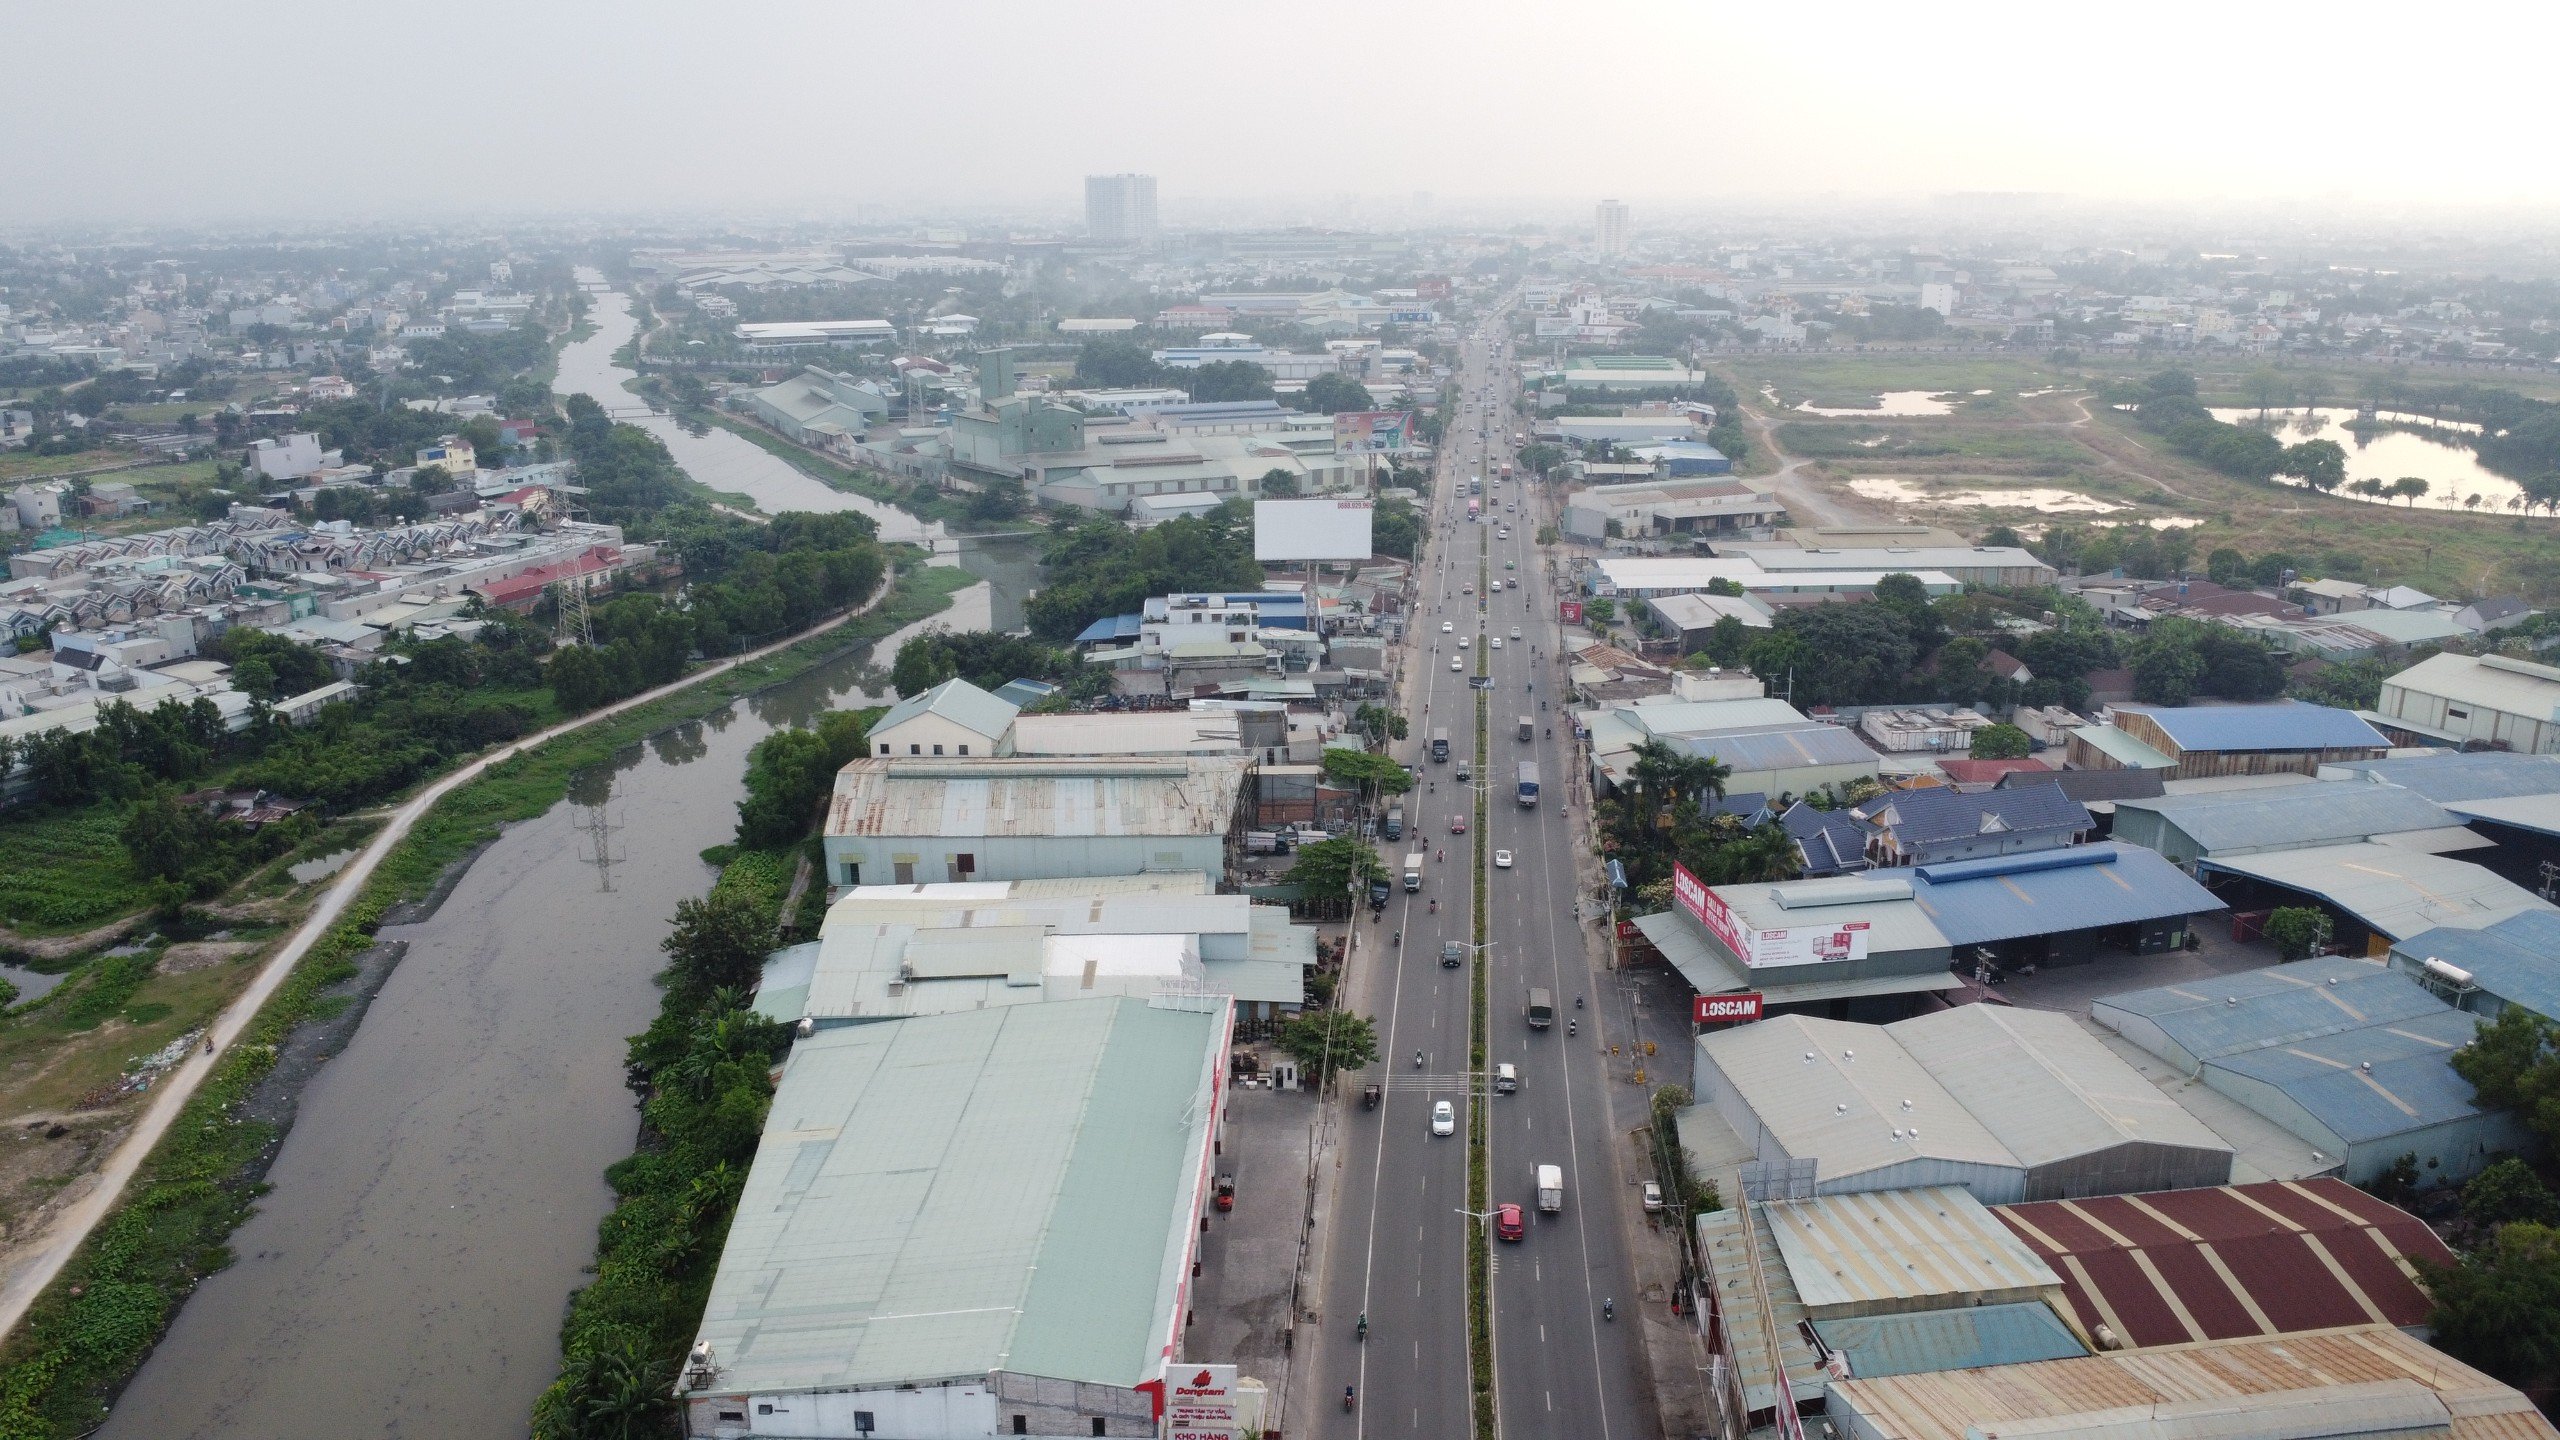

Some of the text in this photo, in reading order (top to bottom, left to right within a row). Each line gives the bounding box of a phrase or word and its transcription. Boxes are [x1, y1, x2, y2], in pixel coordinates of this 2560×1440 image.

[1676, 868, 1705, 910] LOSCAM
[1623, 926, 1640, 935] LOS
[1762, 931, 1787, 939] LOSCAM
[1702, 1001, 1756, 1016] LOSCAM
[1176, 1387, 1225, 1397] Dongtam
[1200, 1431, 1229, 1440] HÀNG
